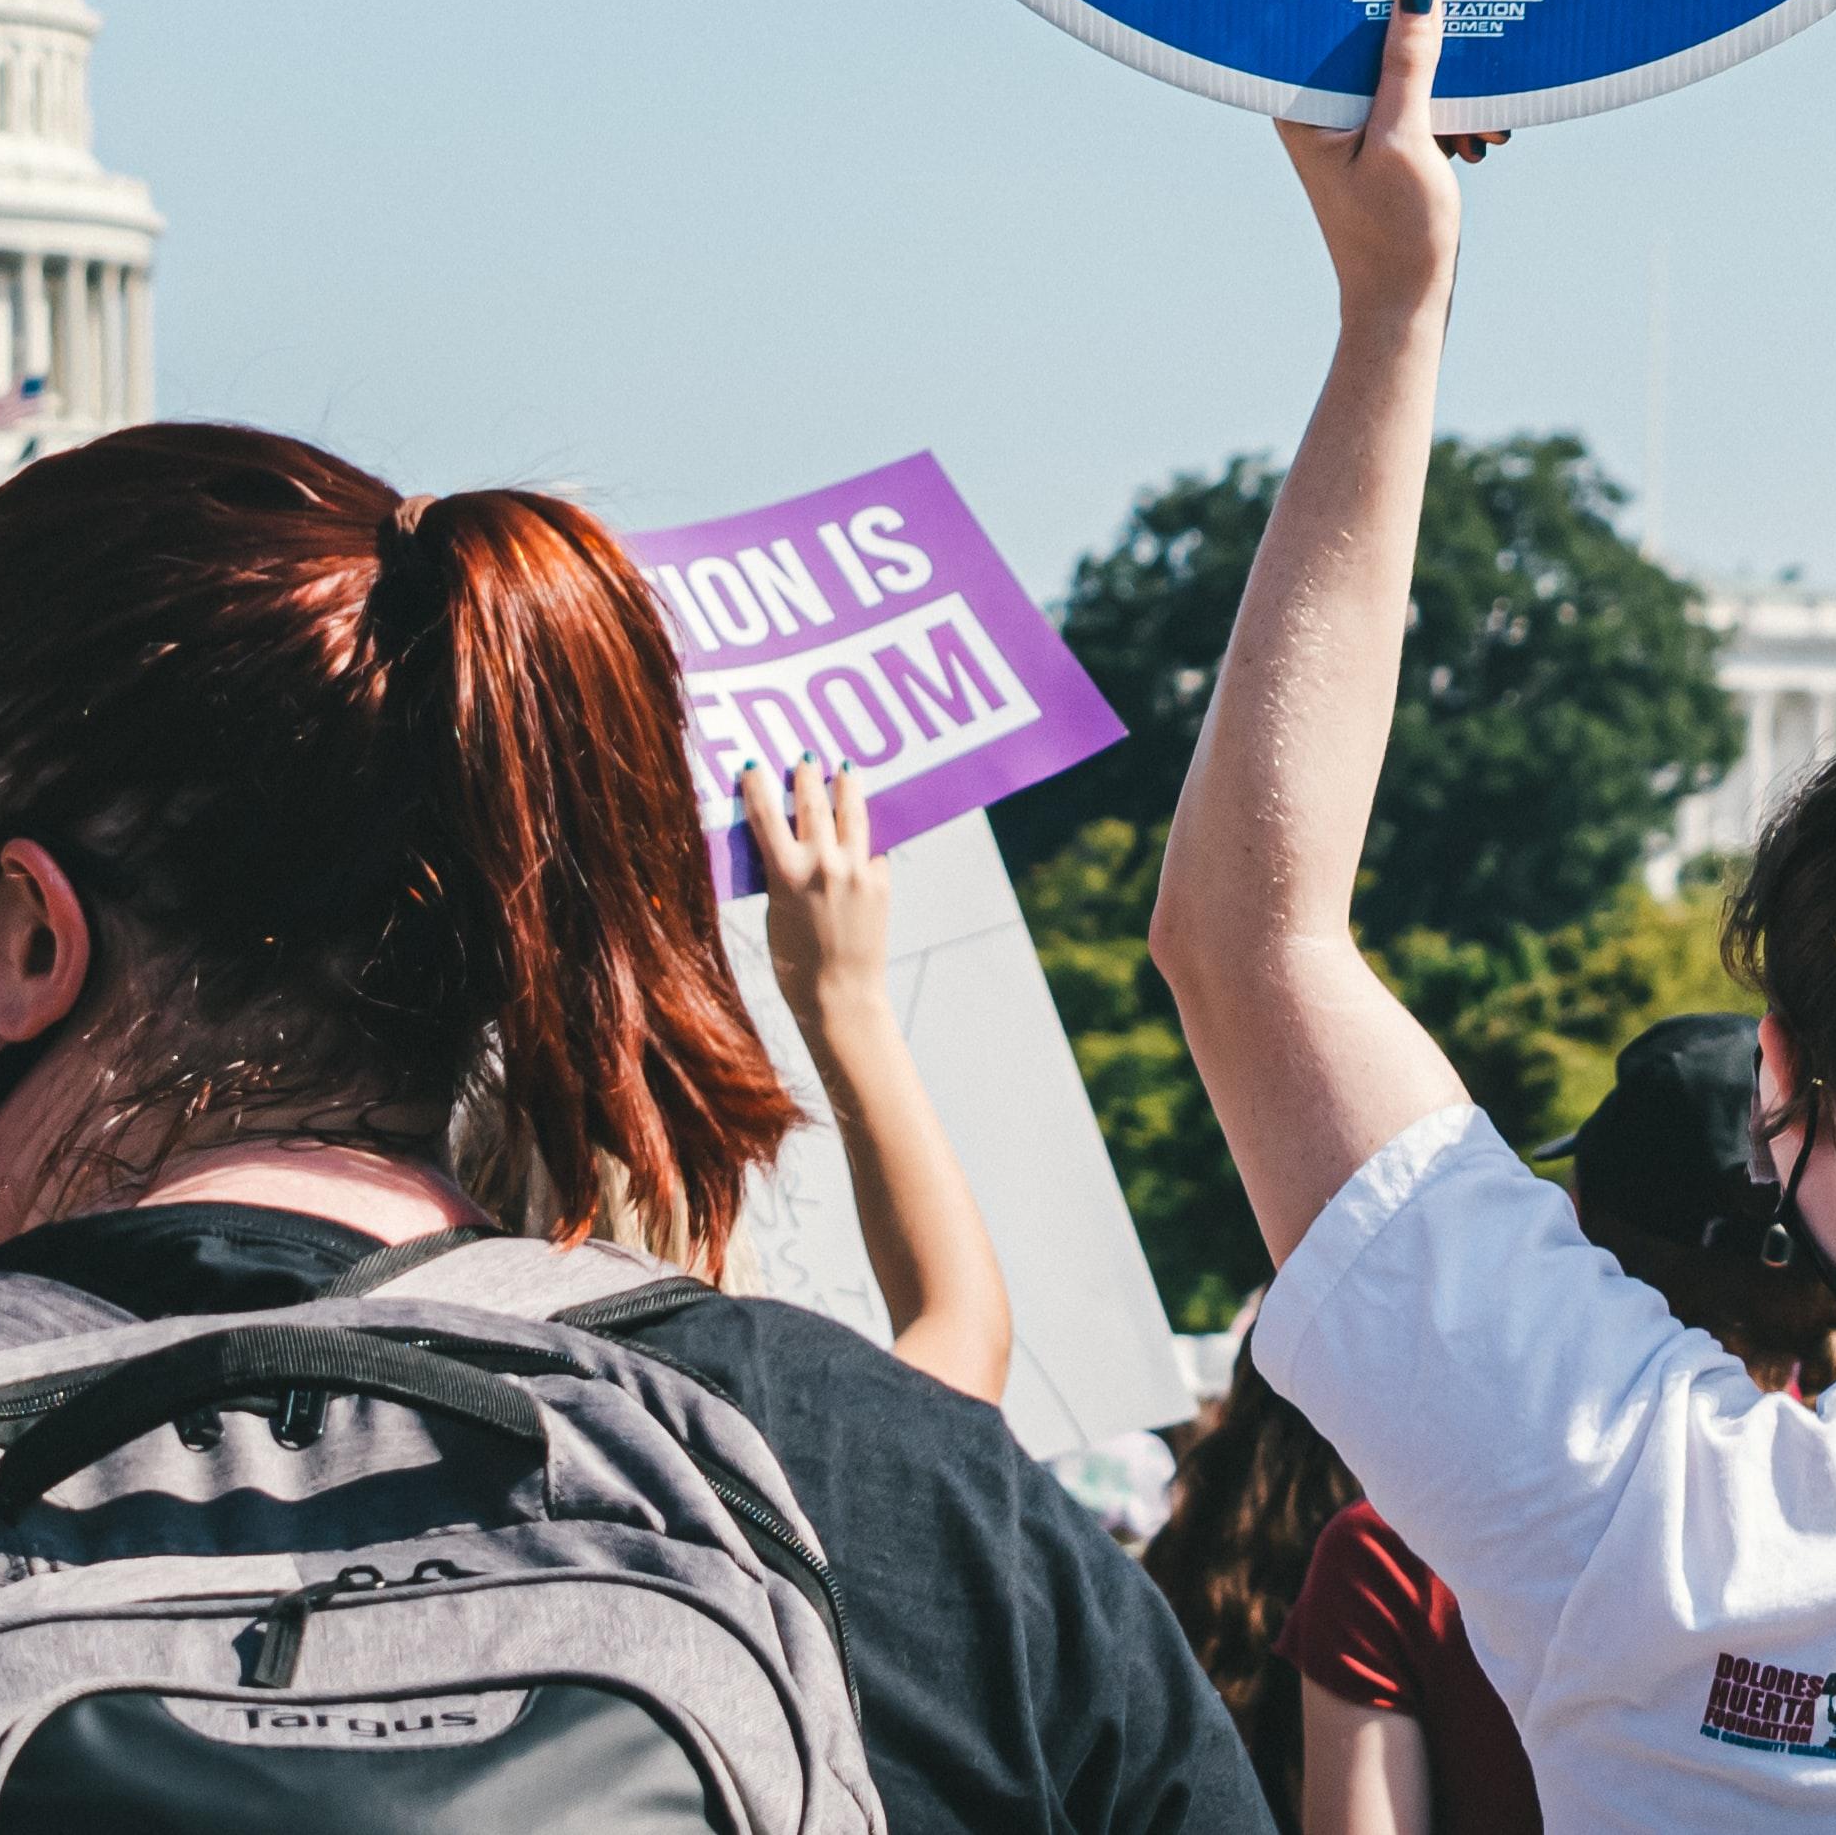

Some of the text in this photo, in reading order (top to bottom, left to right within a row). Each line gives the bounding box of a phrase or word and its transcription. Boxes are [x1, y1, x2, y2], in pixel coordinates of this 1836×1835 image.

[1365, 2, 1526, 16] ORIZATION
[817, 505, 933, 608] IS
[692, 619, 1008, 799] EDOM
[1715, 1652, 1825, 1700] DOLORES
[224, 1705, 478, 1739] Targus
[1707, 1678, 1814, 1726] HUERTA
